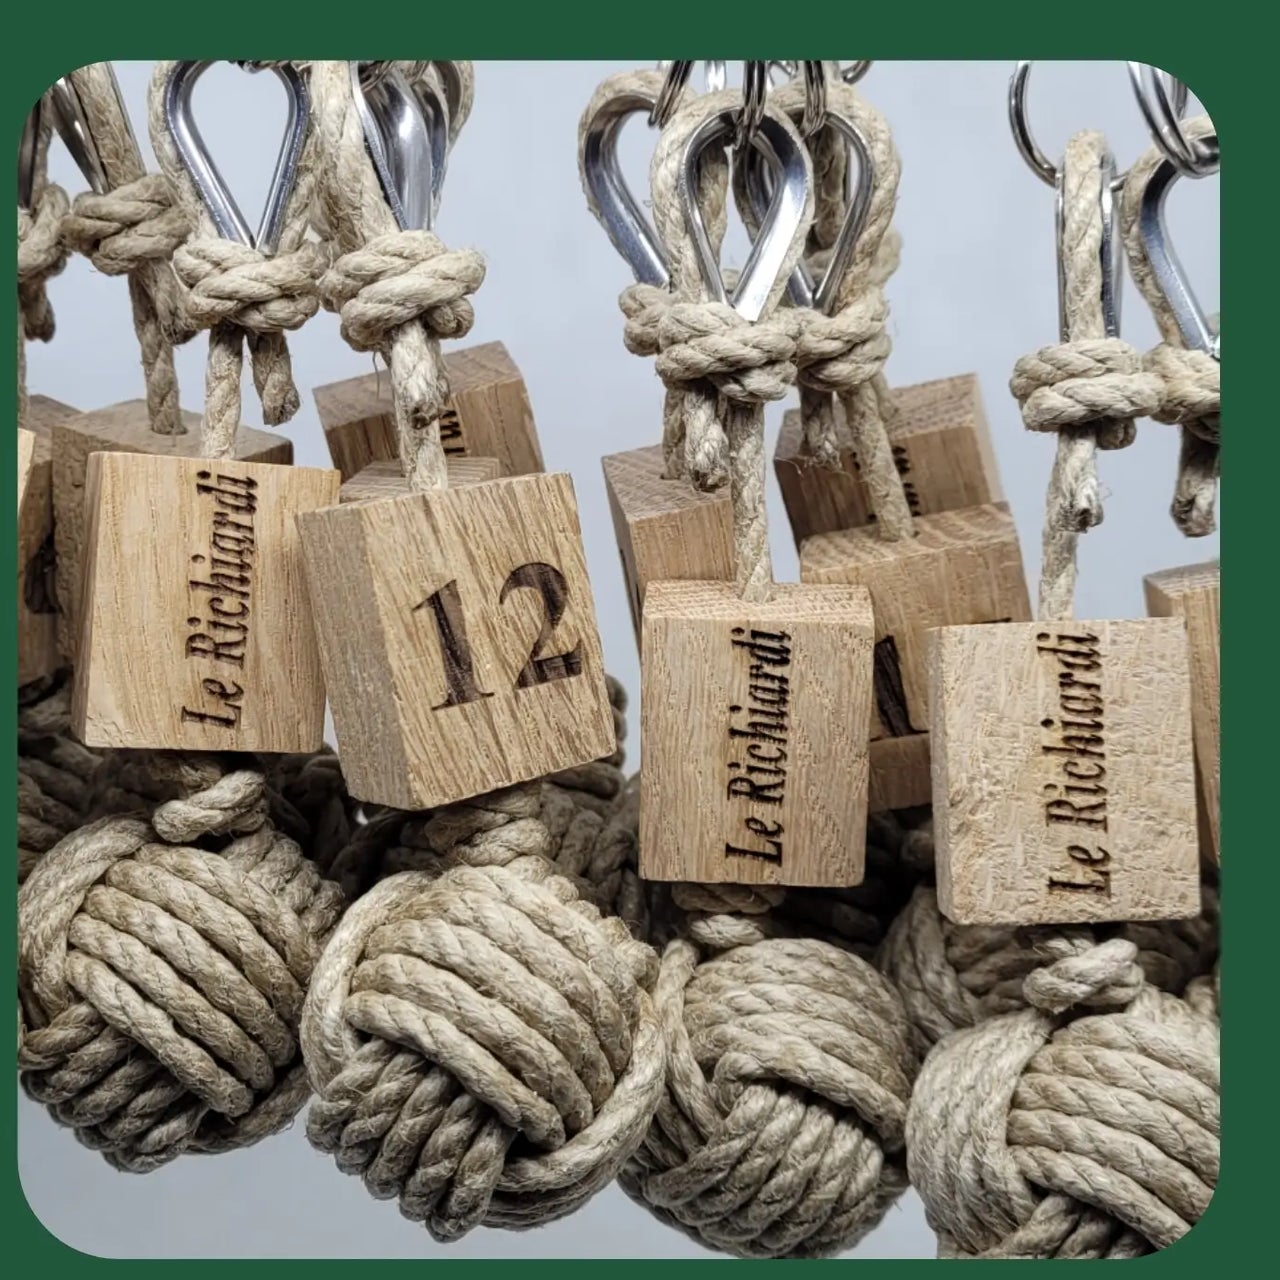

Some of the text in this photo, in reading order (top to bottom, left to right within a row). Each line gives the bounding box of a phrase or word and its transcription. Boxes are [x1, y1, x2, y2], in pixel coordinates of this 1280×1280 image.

[180, 469, 260, 730] Le Richiardi
[411, 561, 584, 712] 12
[725, 626, 792, 869] Le Richiardi
[1036, 631, 1112, 899] Le Richiardi
